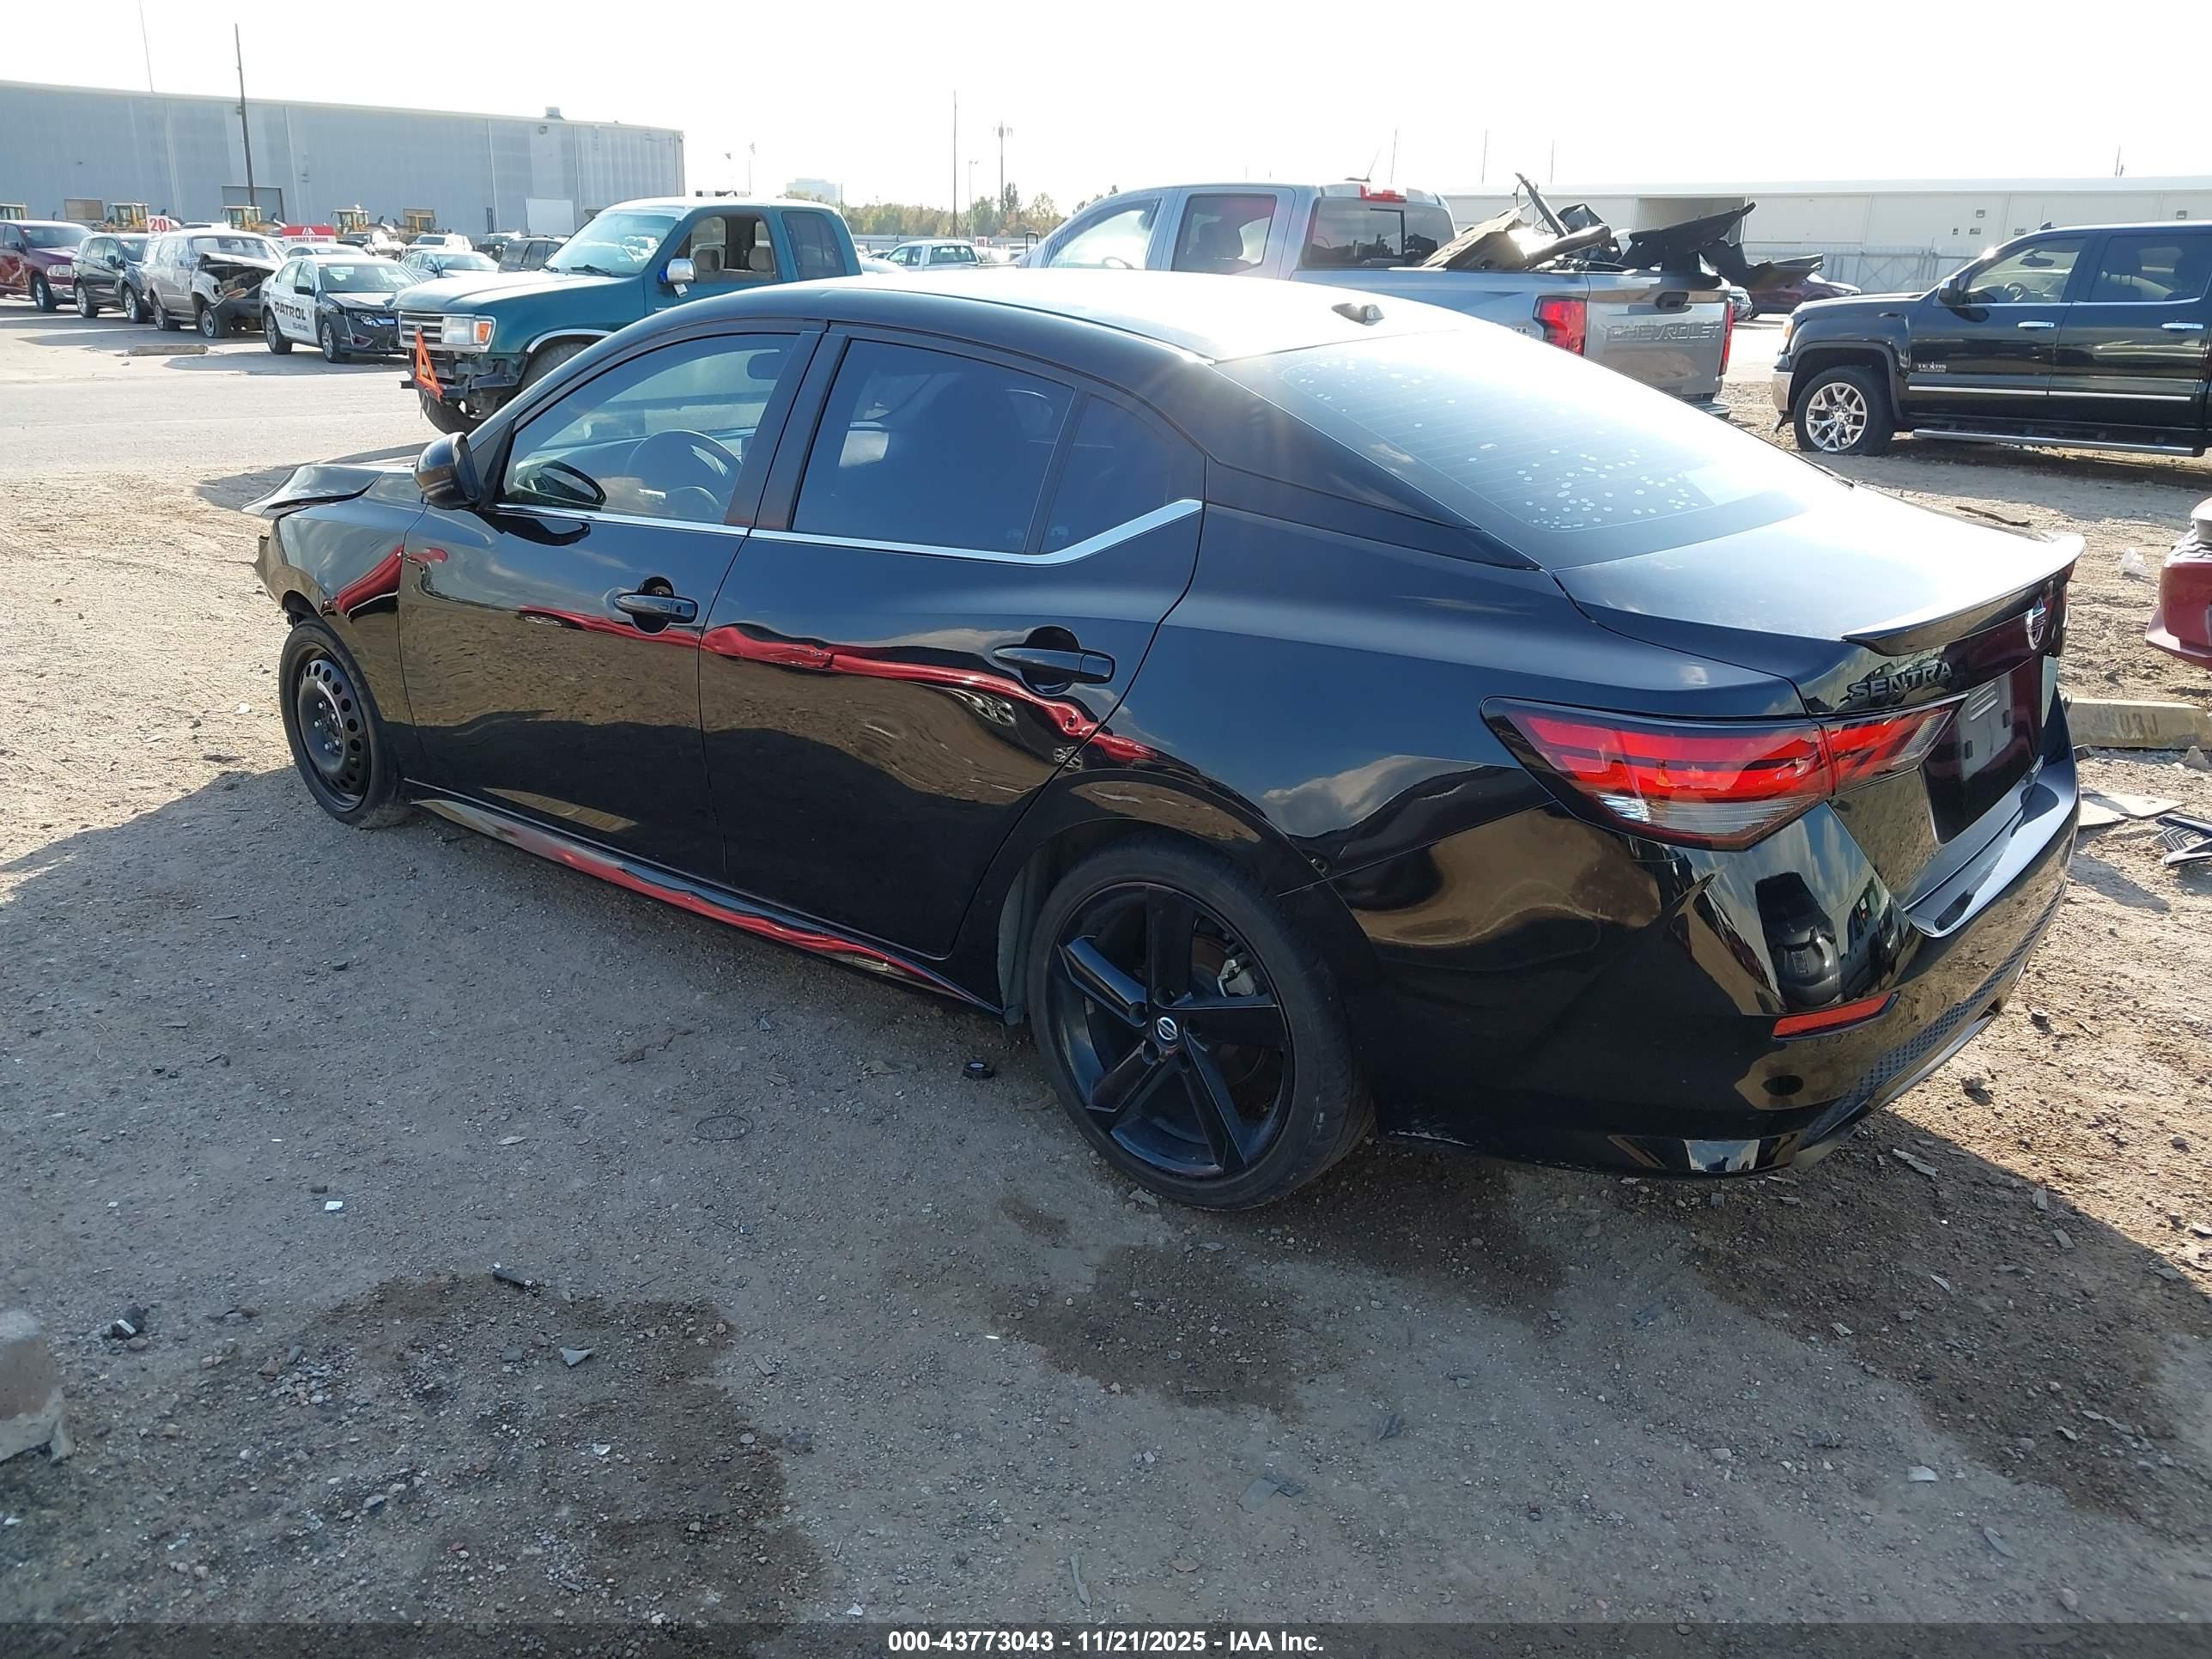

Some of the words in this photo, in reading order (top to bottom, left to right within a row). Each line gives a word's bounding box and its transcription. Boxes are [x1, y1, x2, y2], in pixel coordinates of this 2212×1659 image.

[149, 218, 167, 233] 20
[274, 301, 307, 321] PATROL
[1607, 325, 1720, 341] CHEVROLET
[1850, 661, 1953, 698] SENTRA
